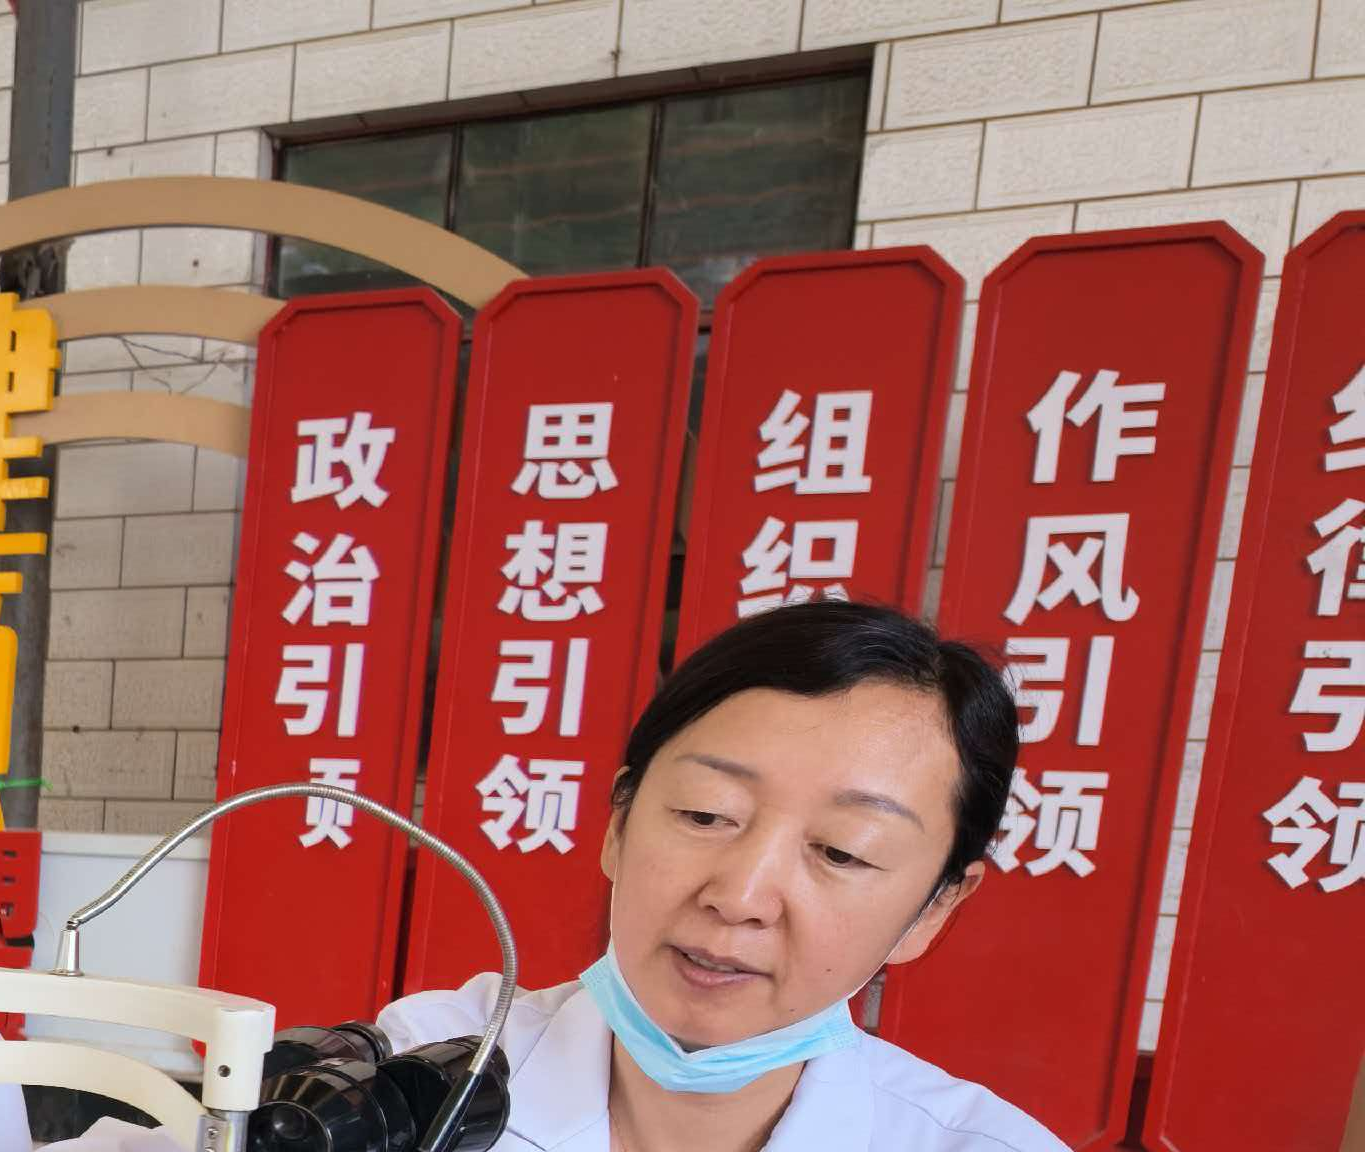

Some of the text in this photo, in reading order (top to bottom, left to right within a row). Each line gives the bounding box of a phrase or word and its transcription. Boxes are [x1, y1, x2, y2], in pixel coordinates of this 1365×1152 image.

[475, 402, 619, 854] 思想引领
[991, 369, 1166, 878] 作风引领
